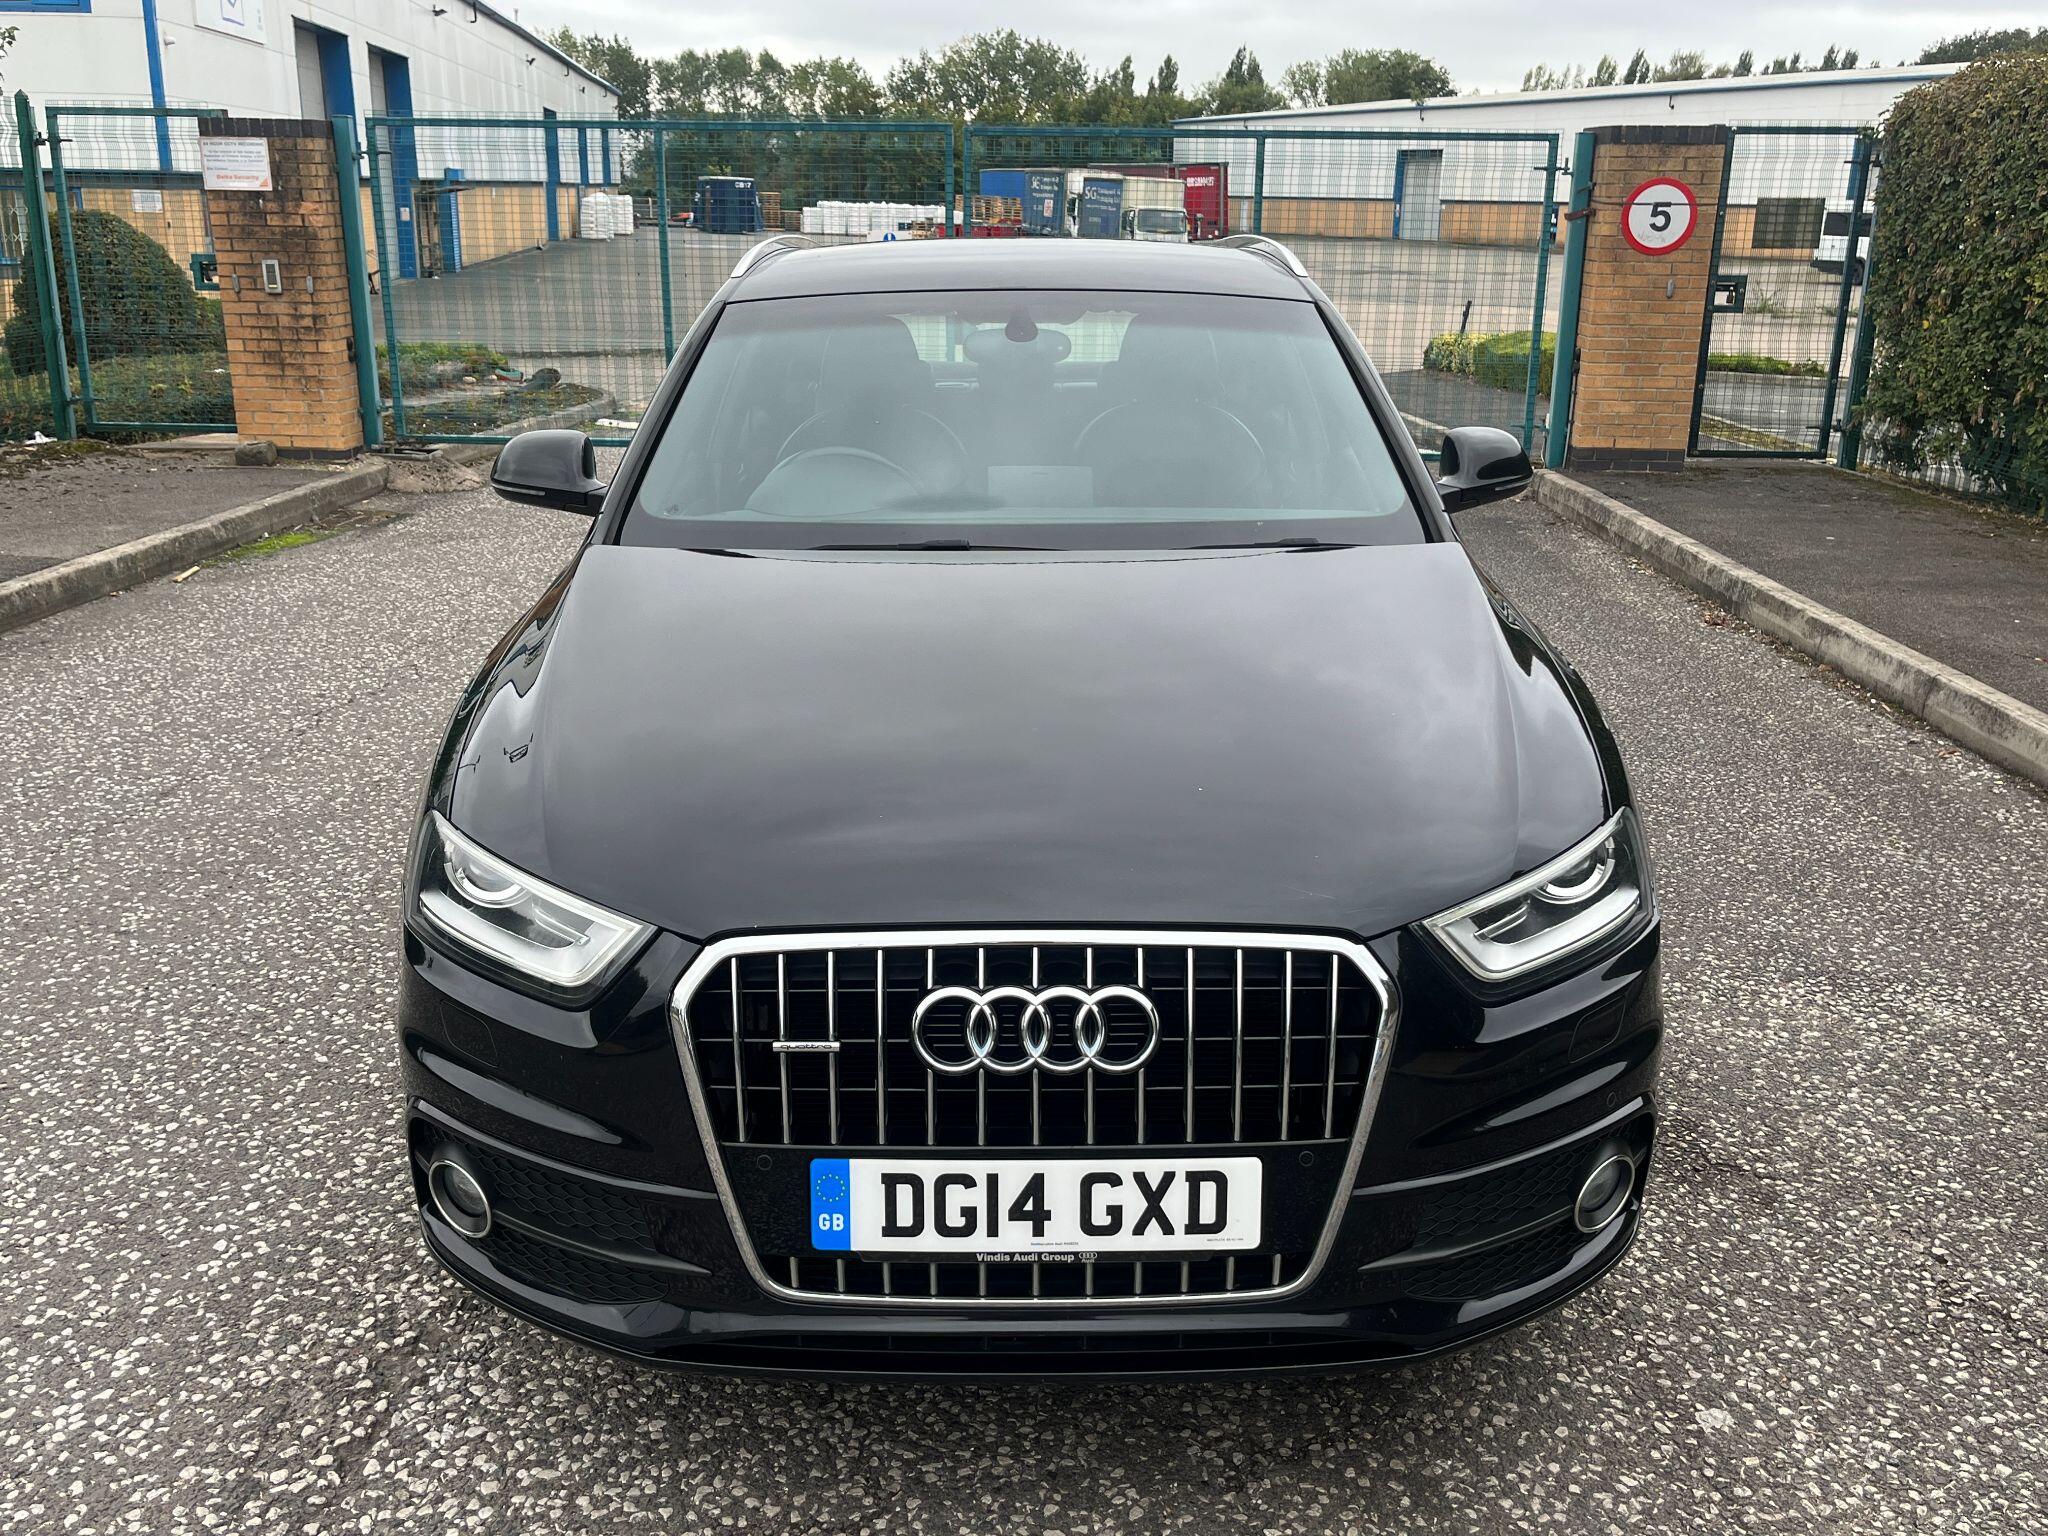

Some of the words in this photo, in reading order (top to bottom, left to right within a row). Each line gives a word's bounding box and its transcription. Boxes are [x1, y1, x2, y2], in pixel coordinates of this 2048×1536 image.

[1649, 201, 1673, 232] 5
[881, 1172, 1052, 1238] DG14
[1079, 1170, 1228, 1237] GXD
[818, 1213, 845, 1231] GB
[976, 1252, 1012, 1263] Vindis
[1013, 1252, 1040, 1263] Audi
[1041, 1252, 1075, 1264] Group
